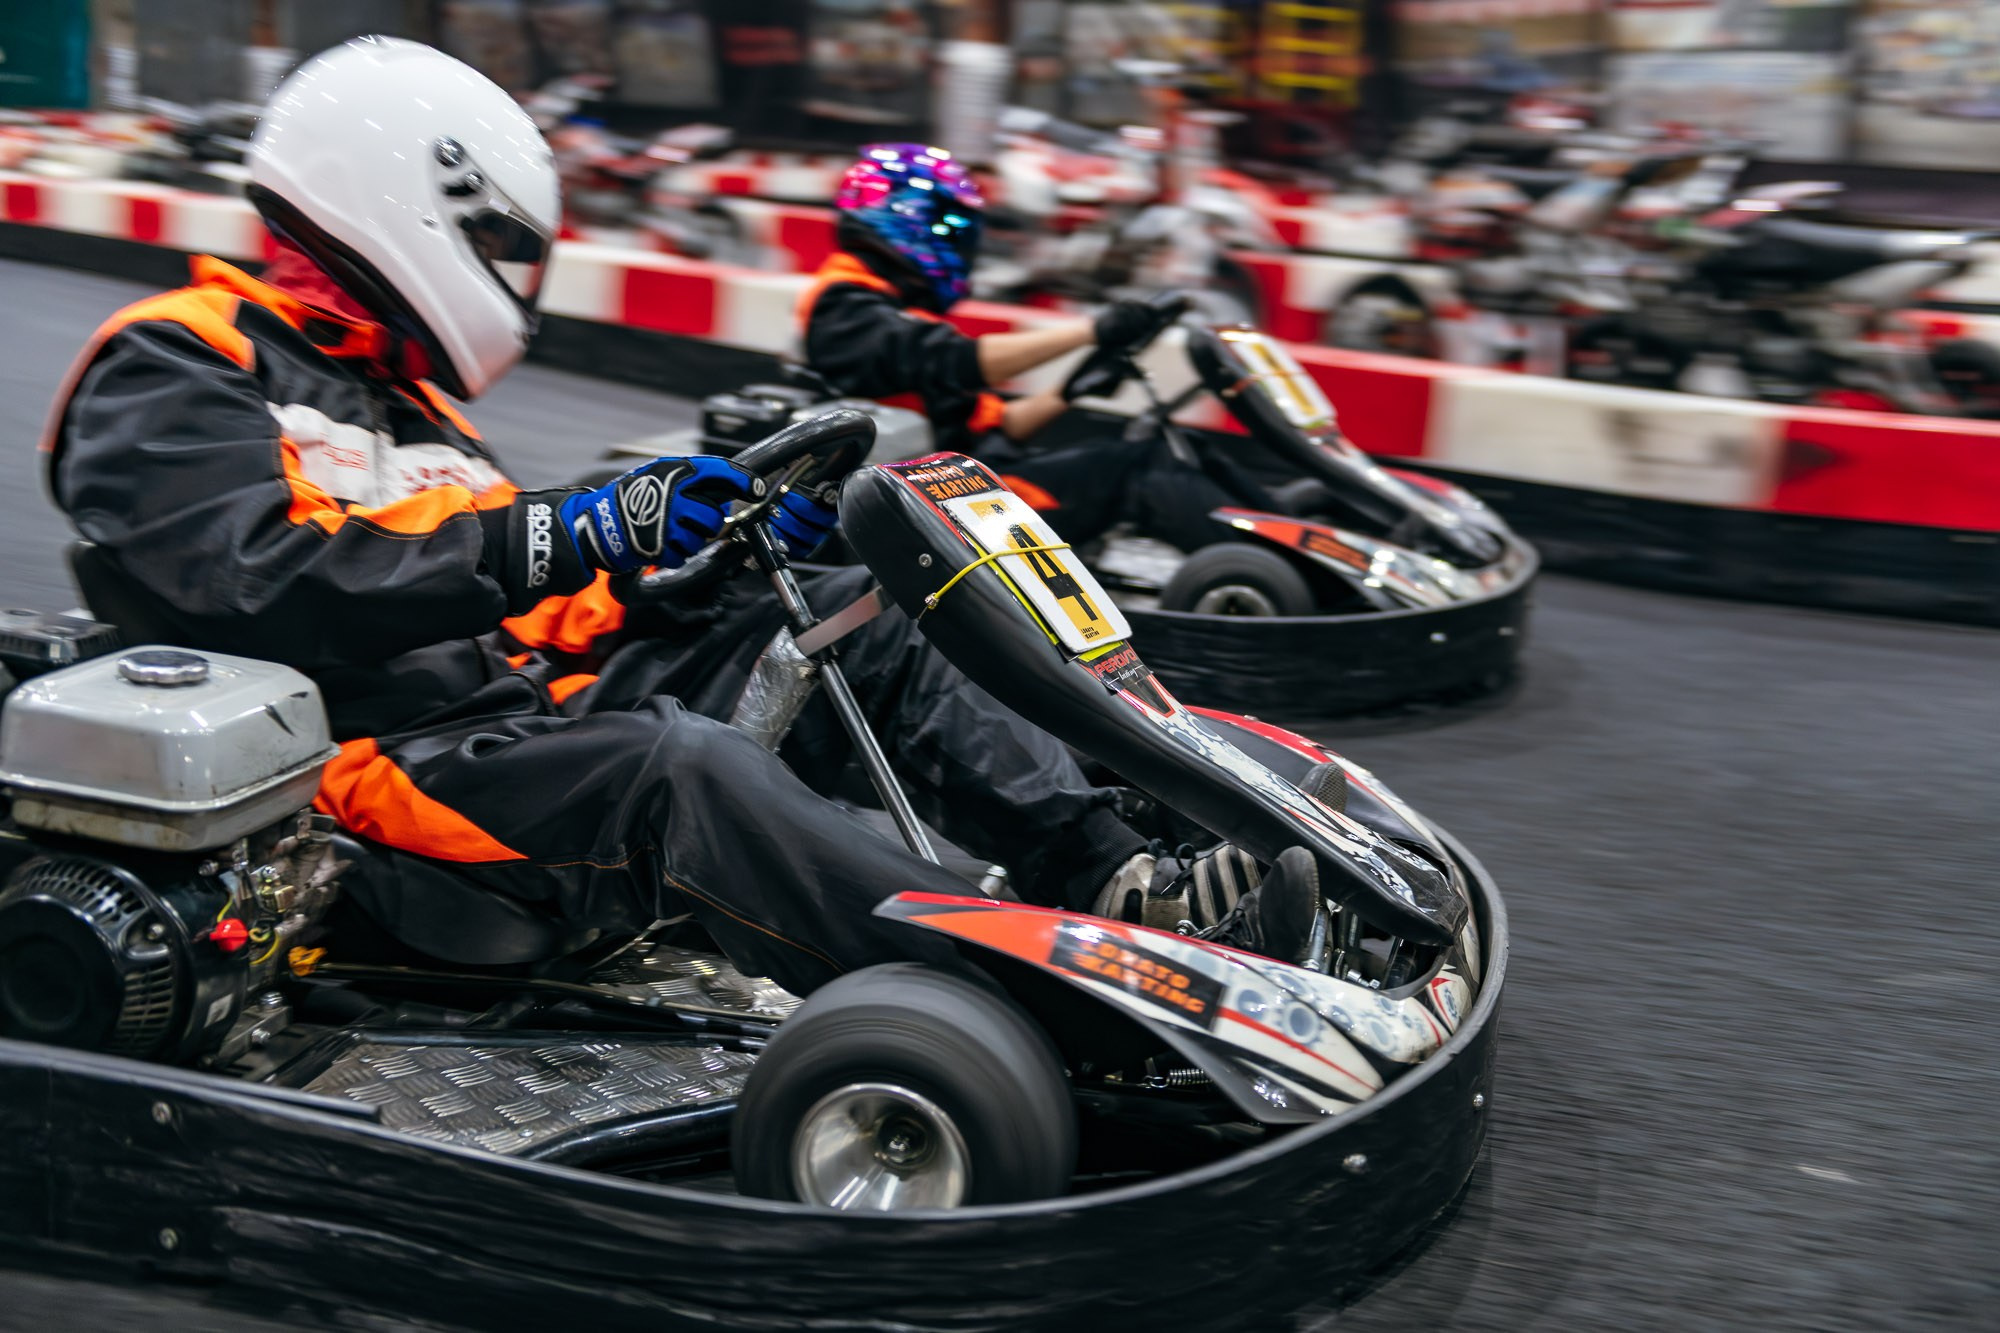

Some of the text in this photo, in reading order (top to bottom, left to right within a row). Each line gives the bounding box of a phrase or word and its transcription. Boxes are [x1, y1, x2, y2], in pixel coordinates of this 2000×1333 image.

[926, 475, 990, 500] KARTING
[526, 503, 552, 588] sparco
[1008, 523, 1098, 621] 4
